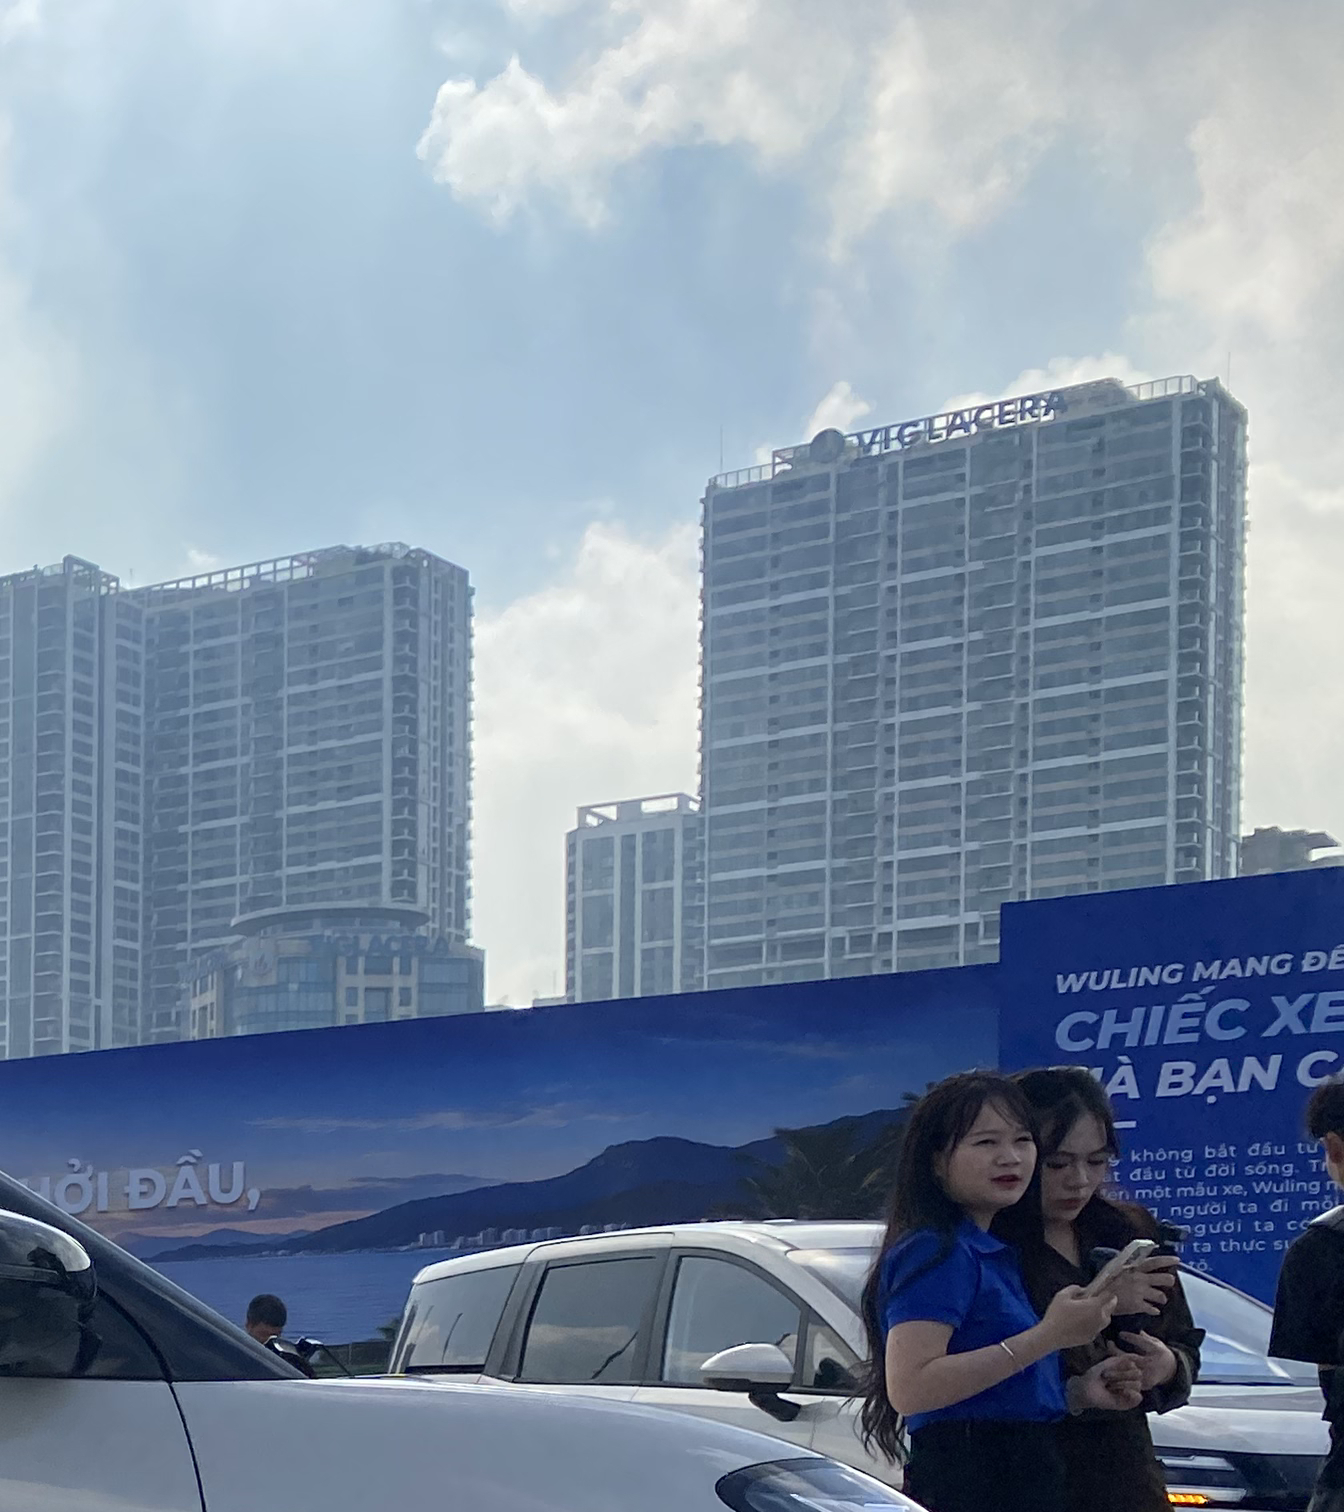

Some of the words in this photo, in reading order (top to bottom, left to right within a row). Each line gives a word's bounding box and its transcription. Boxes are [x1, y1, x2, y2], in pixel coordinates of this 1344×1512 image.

[855, 391, 1068, 451] VIGLACERA
[1056, 963, 1185, 994] WULING
[1192, 953, 1294, 982] MANG
[1055, 985, 1252, 1052] CHIẾC
[1261, 990, 1344, 1037] XE
[1155, 1054, 1283, 1104] BẠN
[1131, 1147, 1193, 1163] không
[124, 1149, 261, 1212] ĐẦU,
[1204, 1162, 1235, 1178] đời
[1244, 1161, 1300, 1178] sống.
[1135, 1185, 1172, 1202] một
[1176, 1181, 1218, 1198] mẫu
[1223, 1183, 1248, 1197] xe,
[1253, 1179, 1321, 1195] Wuling
[1170, 1201, 1227, 1219] người
[1238, 1202, 1258, 1214] ta
[1270, 1198, 1289, 1212] đi
[1254, 1220, 1274, 1232] ta
[1193, 1242, 1211, 1253] ta
[1220, 1238, 1266, 1255] thực
